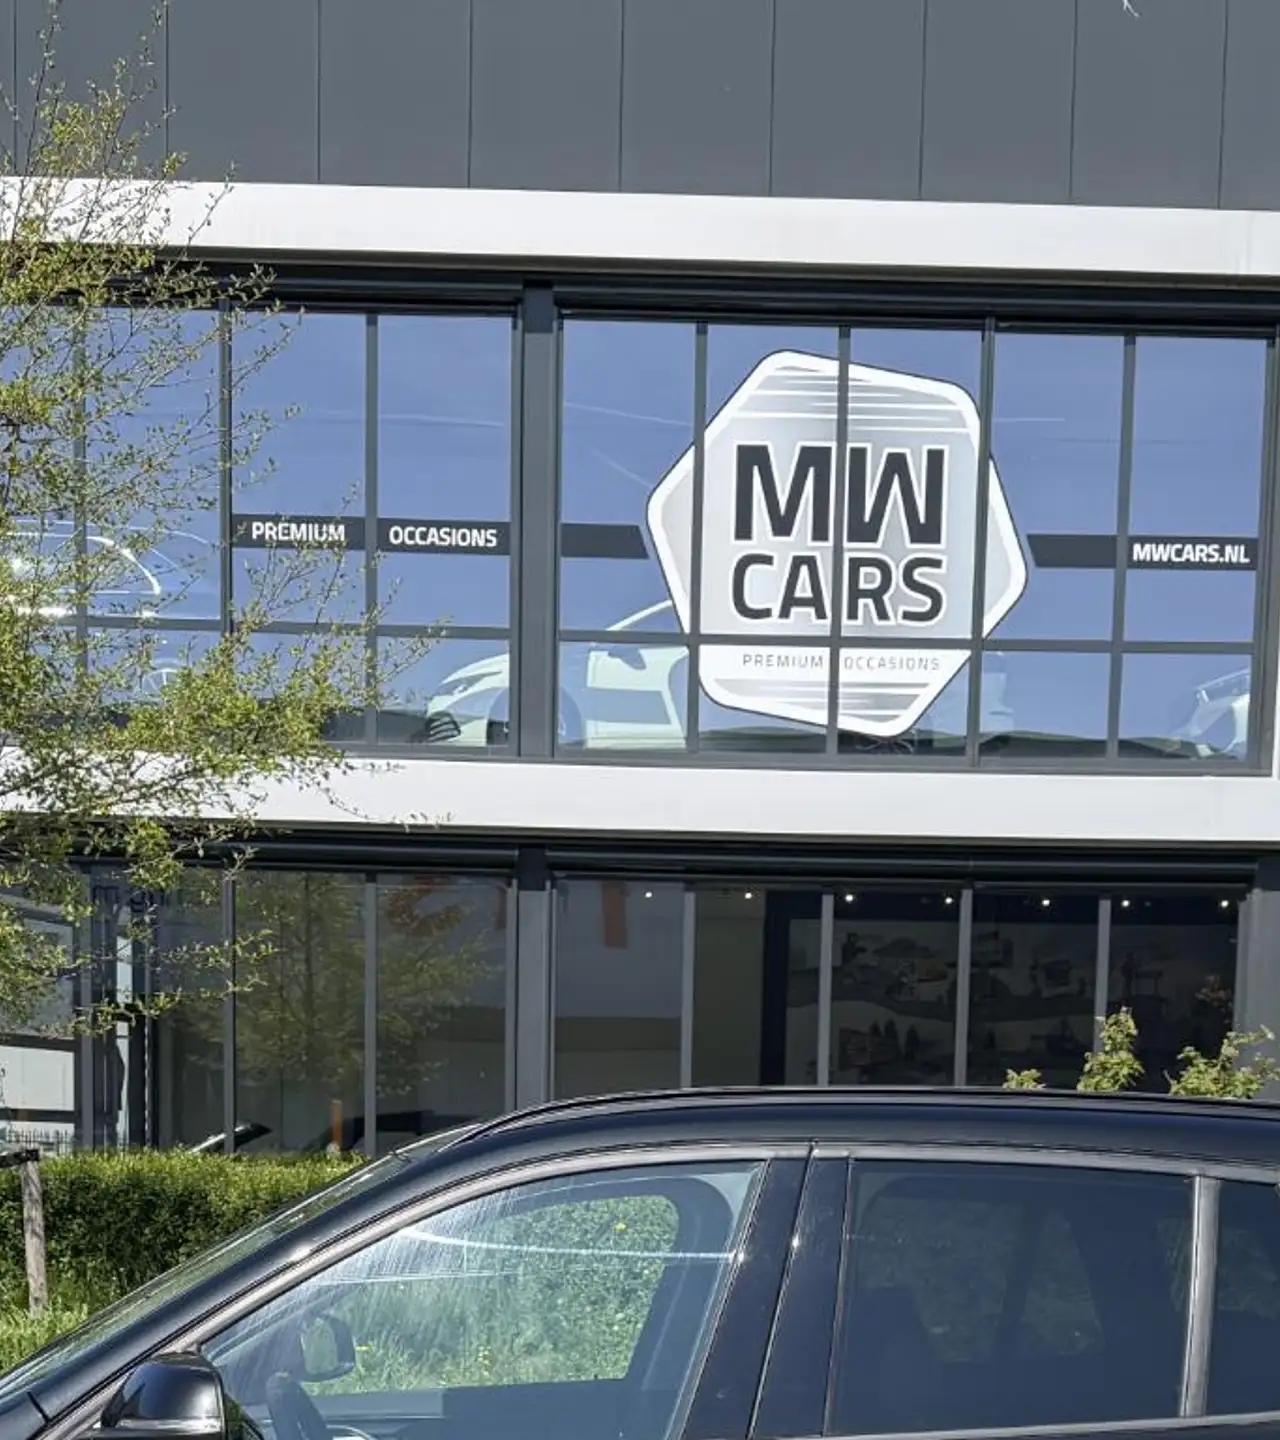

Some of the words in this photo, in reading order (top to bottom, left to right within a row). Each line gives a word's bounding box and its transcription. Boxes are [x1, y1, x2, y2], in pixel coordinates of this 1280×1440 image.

[734, 444, 945, 545] MW
[251, 521, 345, 542] PREMIUM
[389, 525, 497, 548] OCCASIONS
[1132, 543, 1251, 564] MWCARS.NL
[732, 553, 944, 623] CARS
[742, 653, 824, 669] PREMIUM
[843, 655, 940, 671] OCCASIONS
